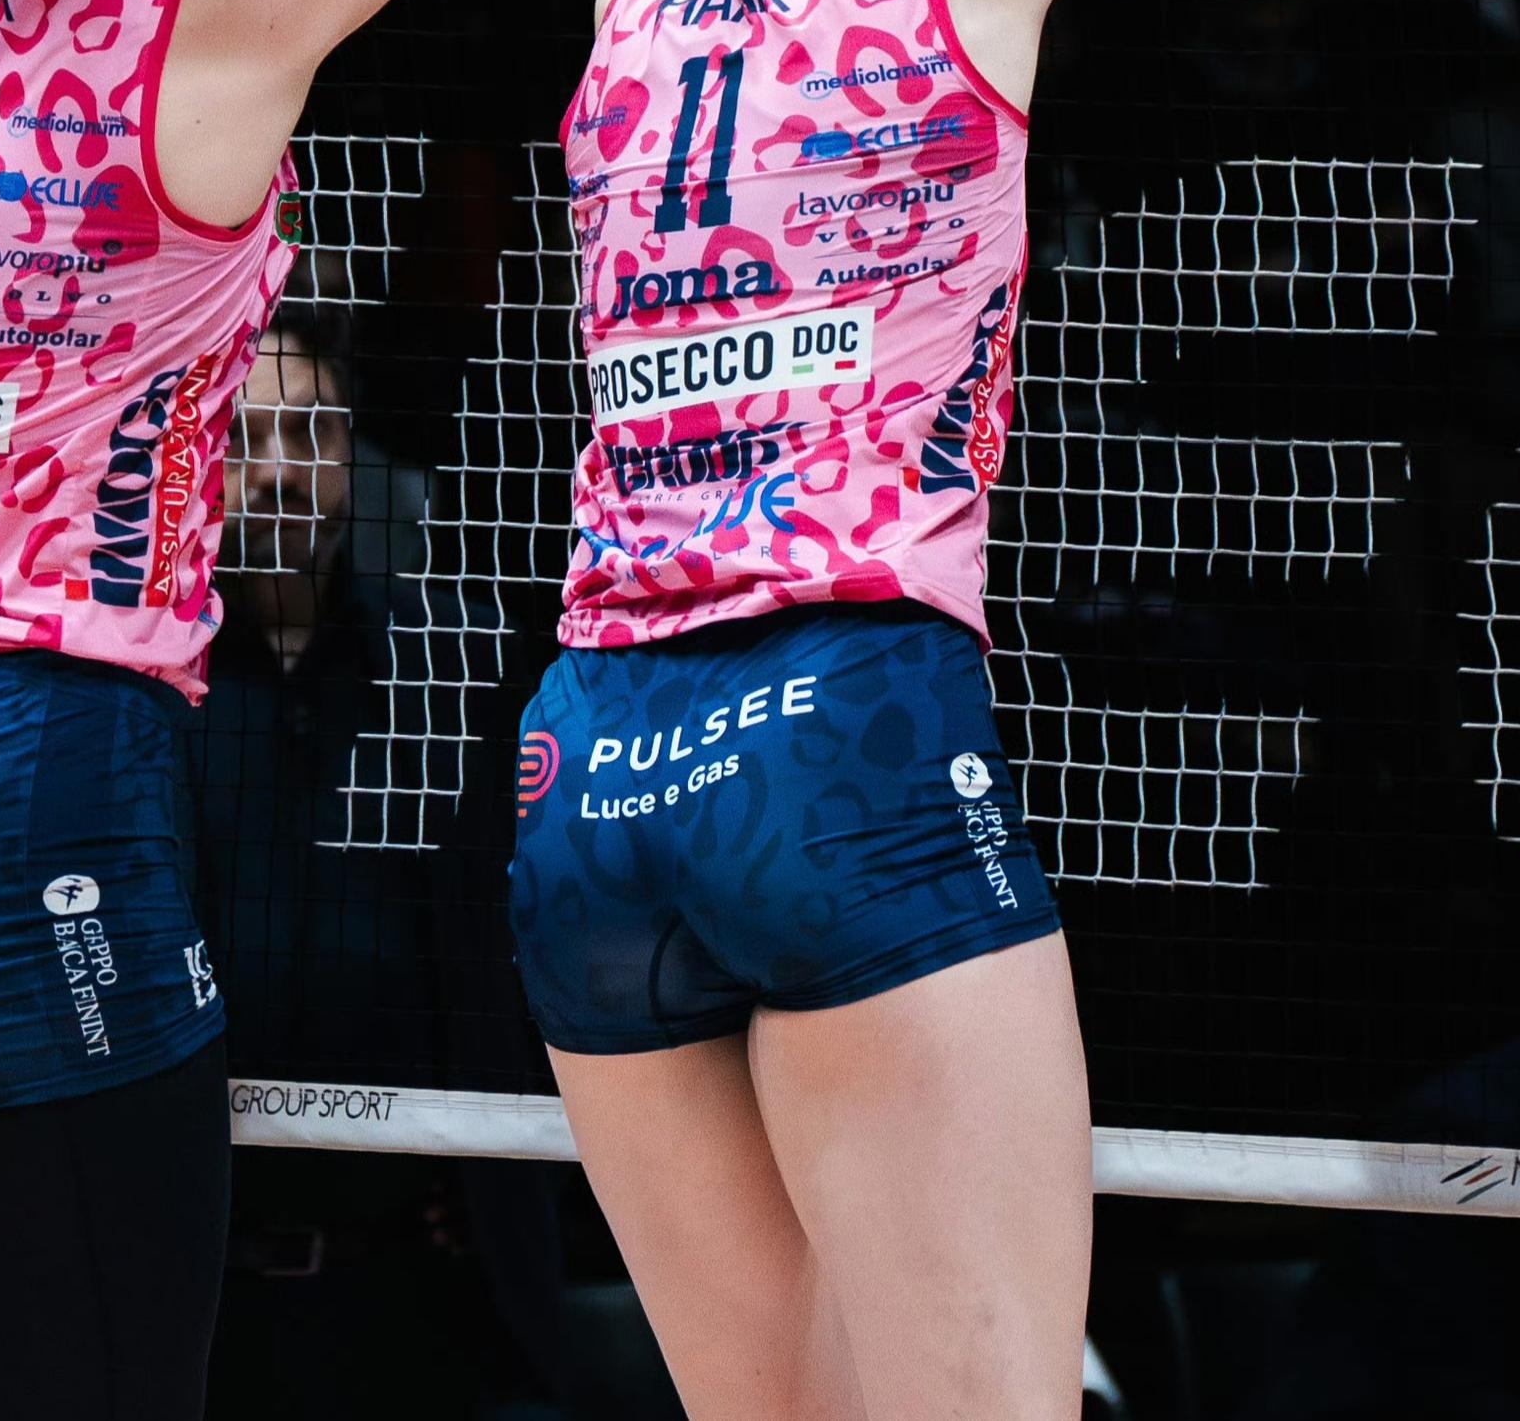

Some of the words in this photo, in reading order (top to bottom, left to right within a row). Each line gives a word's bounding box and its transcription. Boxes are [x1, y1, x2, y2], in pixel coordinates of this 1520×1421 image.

[653, 48, 744, 235] 11
[791, 320, 859, 359] DOC
[587, 675, 818, 773] PULSEE
[581, 791, 656, 820] Luce
[664, 790, 680, 808] e
[686, 751, 740, 792] Gas
